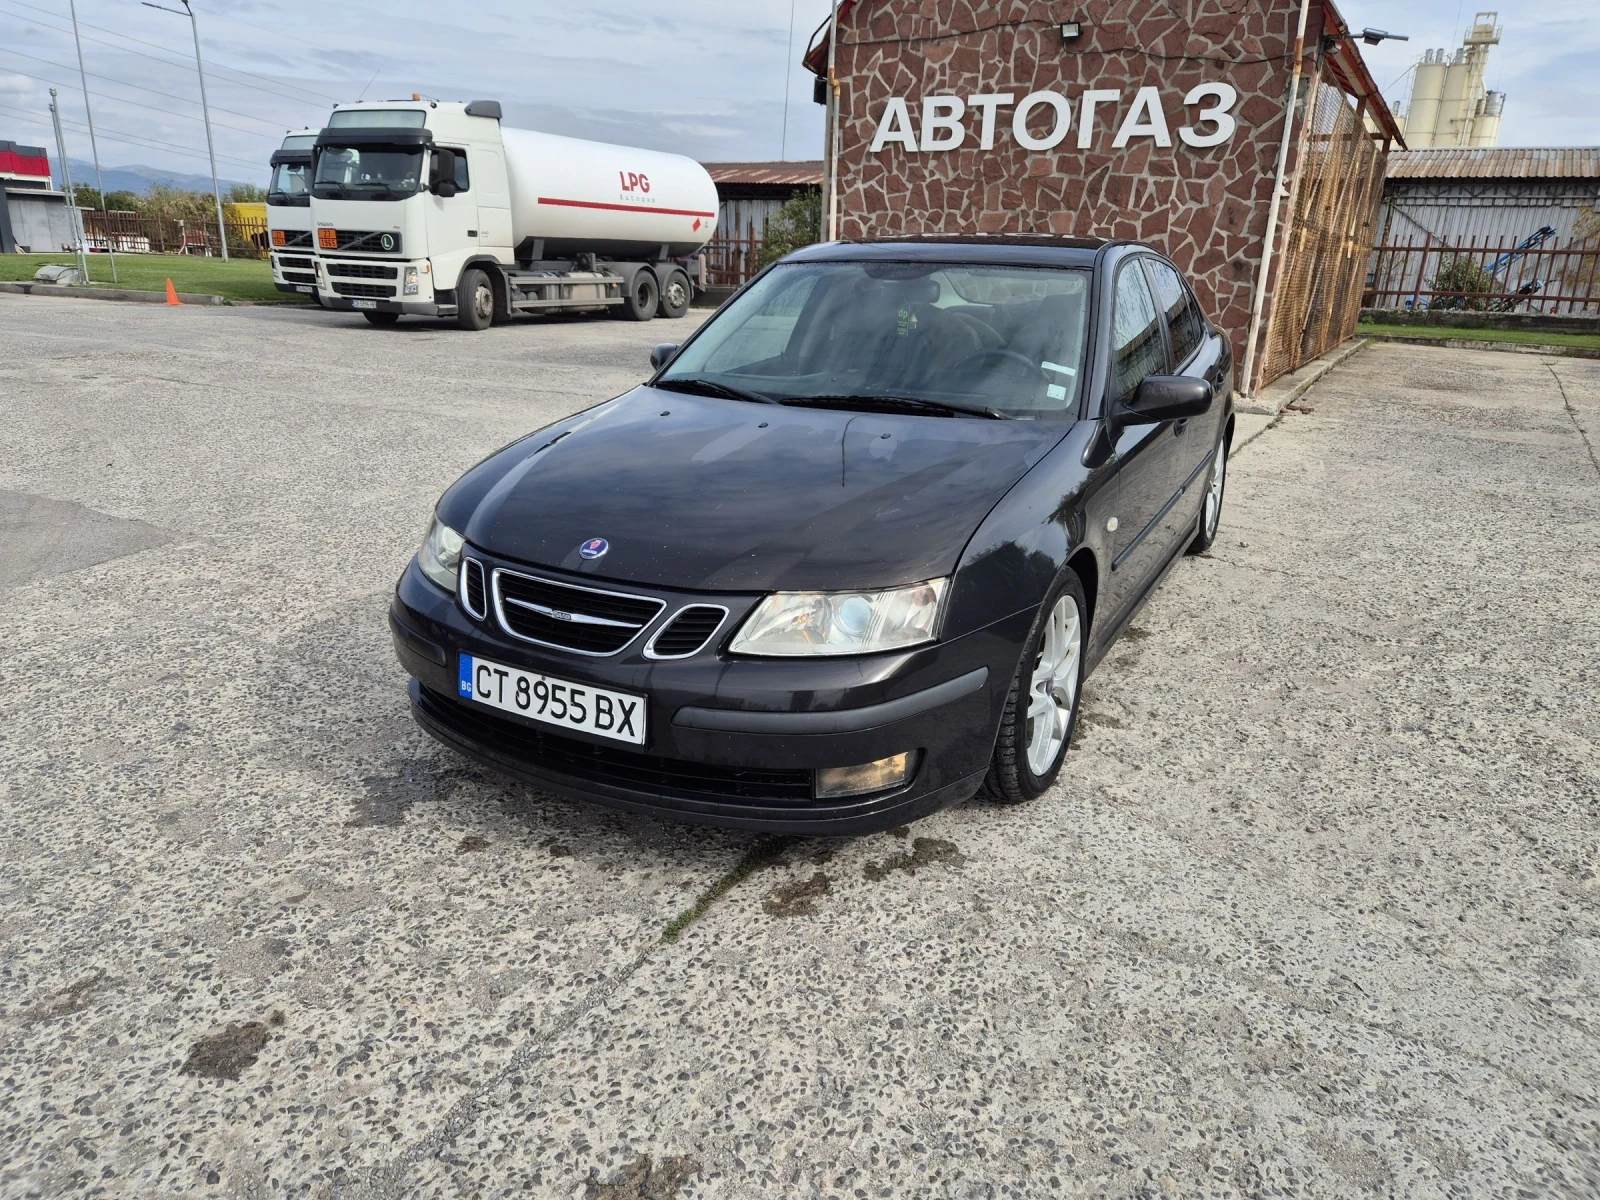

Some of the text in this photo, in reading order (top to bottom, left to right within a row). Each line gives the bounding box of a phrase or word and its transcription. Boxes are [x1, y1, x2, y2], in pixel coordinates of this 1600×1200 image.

[869, 82, 1238, 153] АВТОГАЗ
[619, 171, 650, 193] LPG
[323, 230, 331, 238] 23
[321, 239, 336, 247] 1965
[383, 237, 391, 247] L
[461, 680, 472, 693] BG
[476, 664, 637, 737] CT 8955 BX
